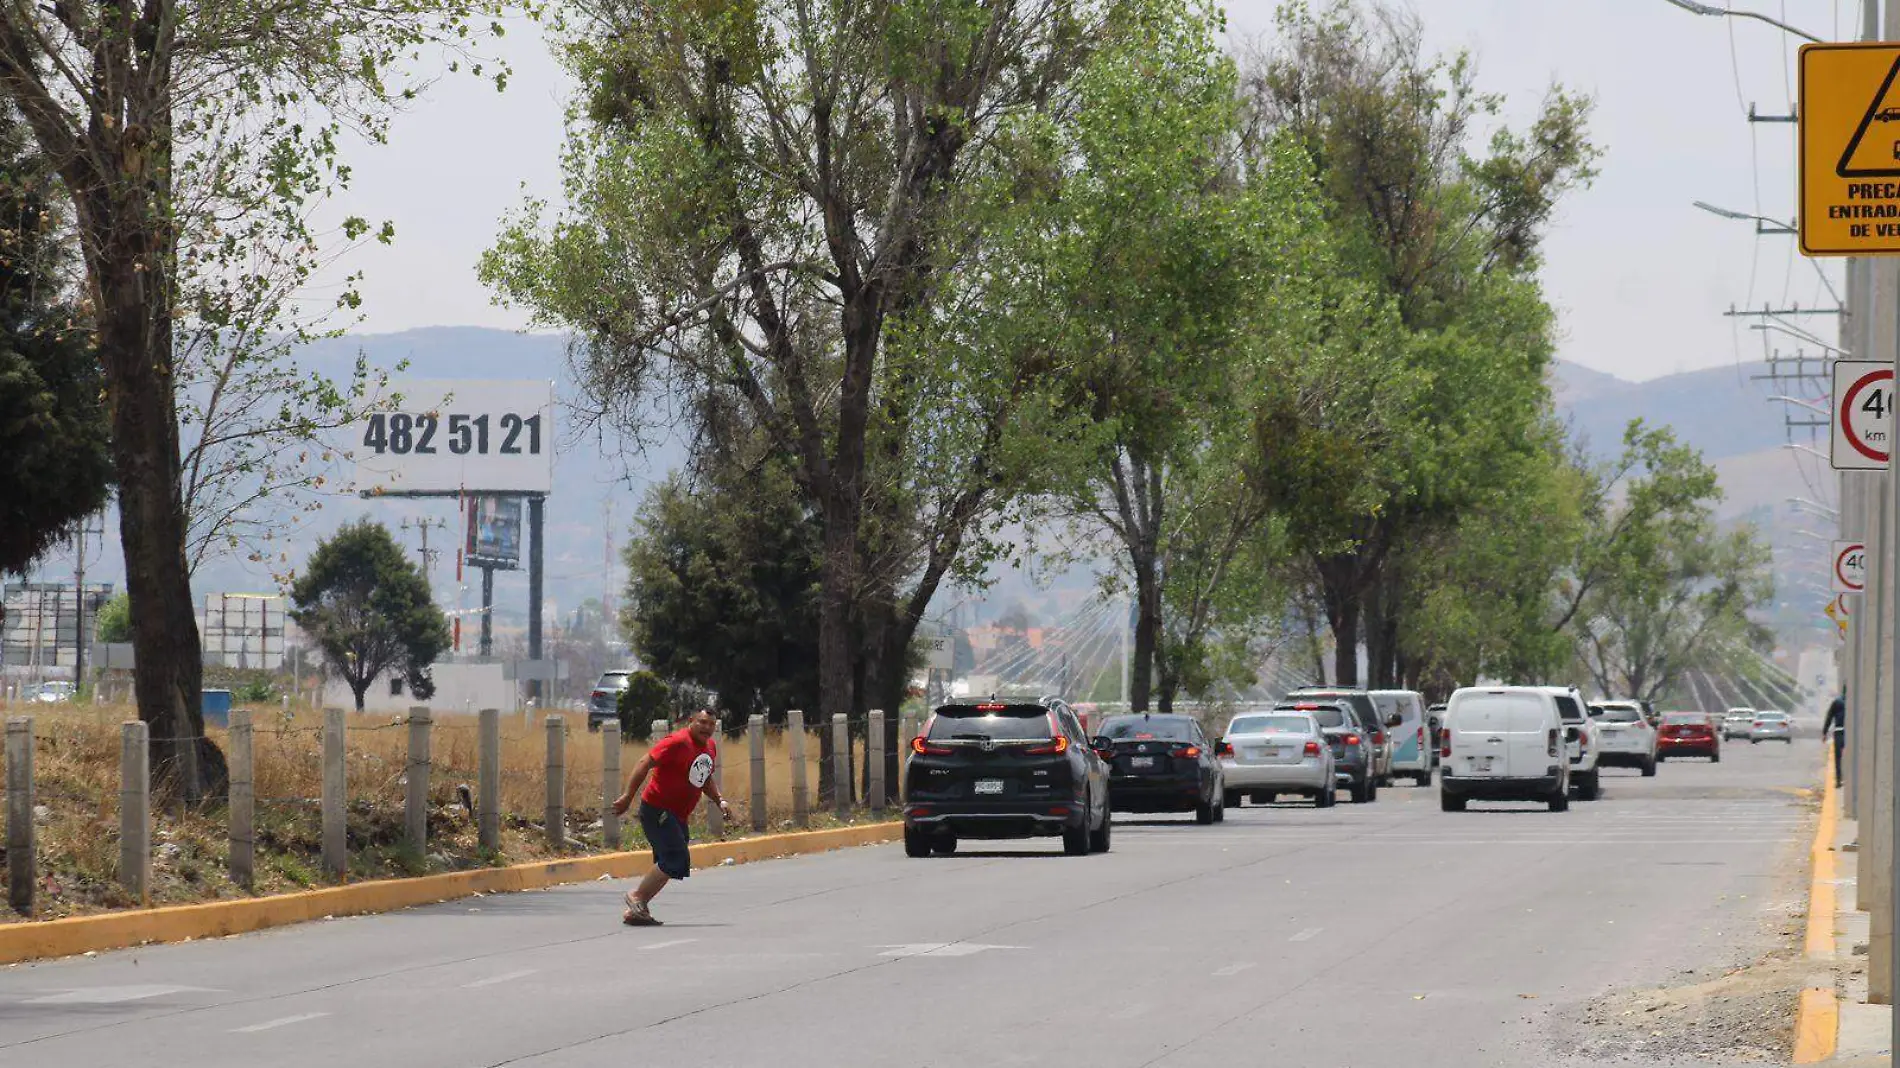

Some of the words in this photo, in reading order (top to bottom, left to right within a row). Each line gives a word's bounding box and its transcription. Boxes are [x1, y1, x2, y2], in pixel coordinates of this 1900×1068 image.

[1850, 223, 1871, 237] DE
[363, 413, 439, 455] 482
[448, 413, 489, 455] 51
[499, 412, 541, 455] 21
